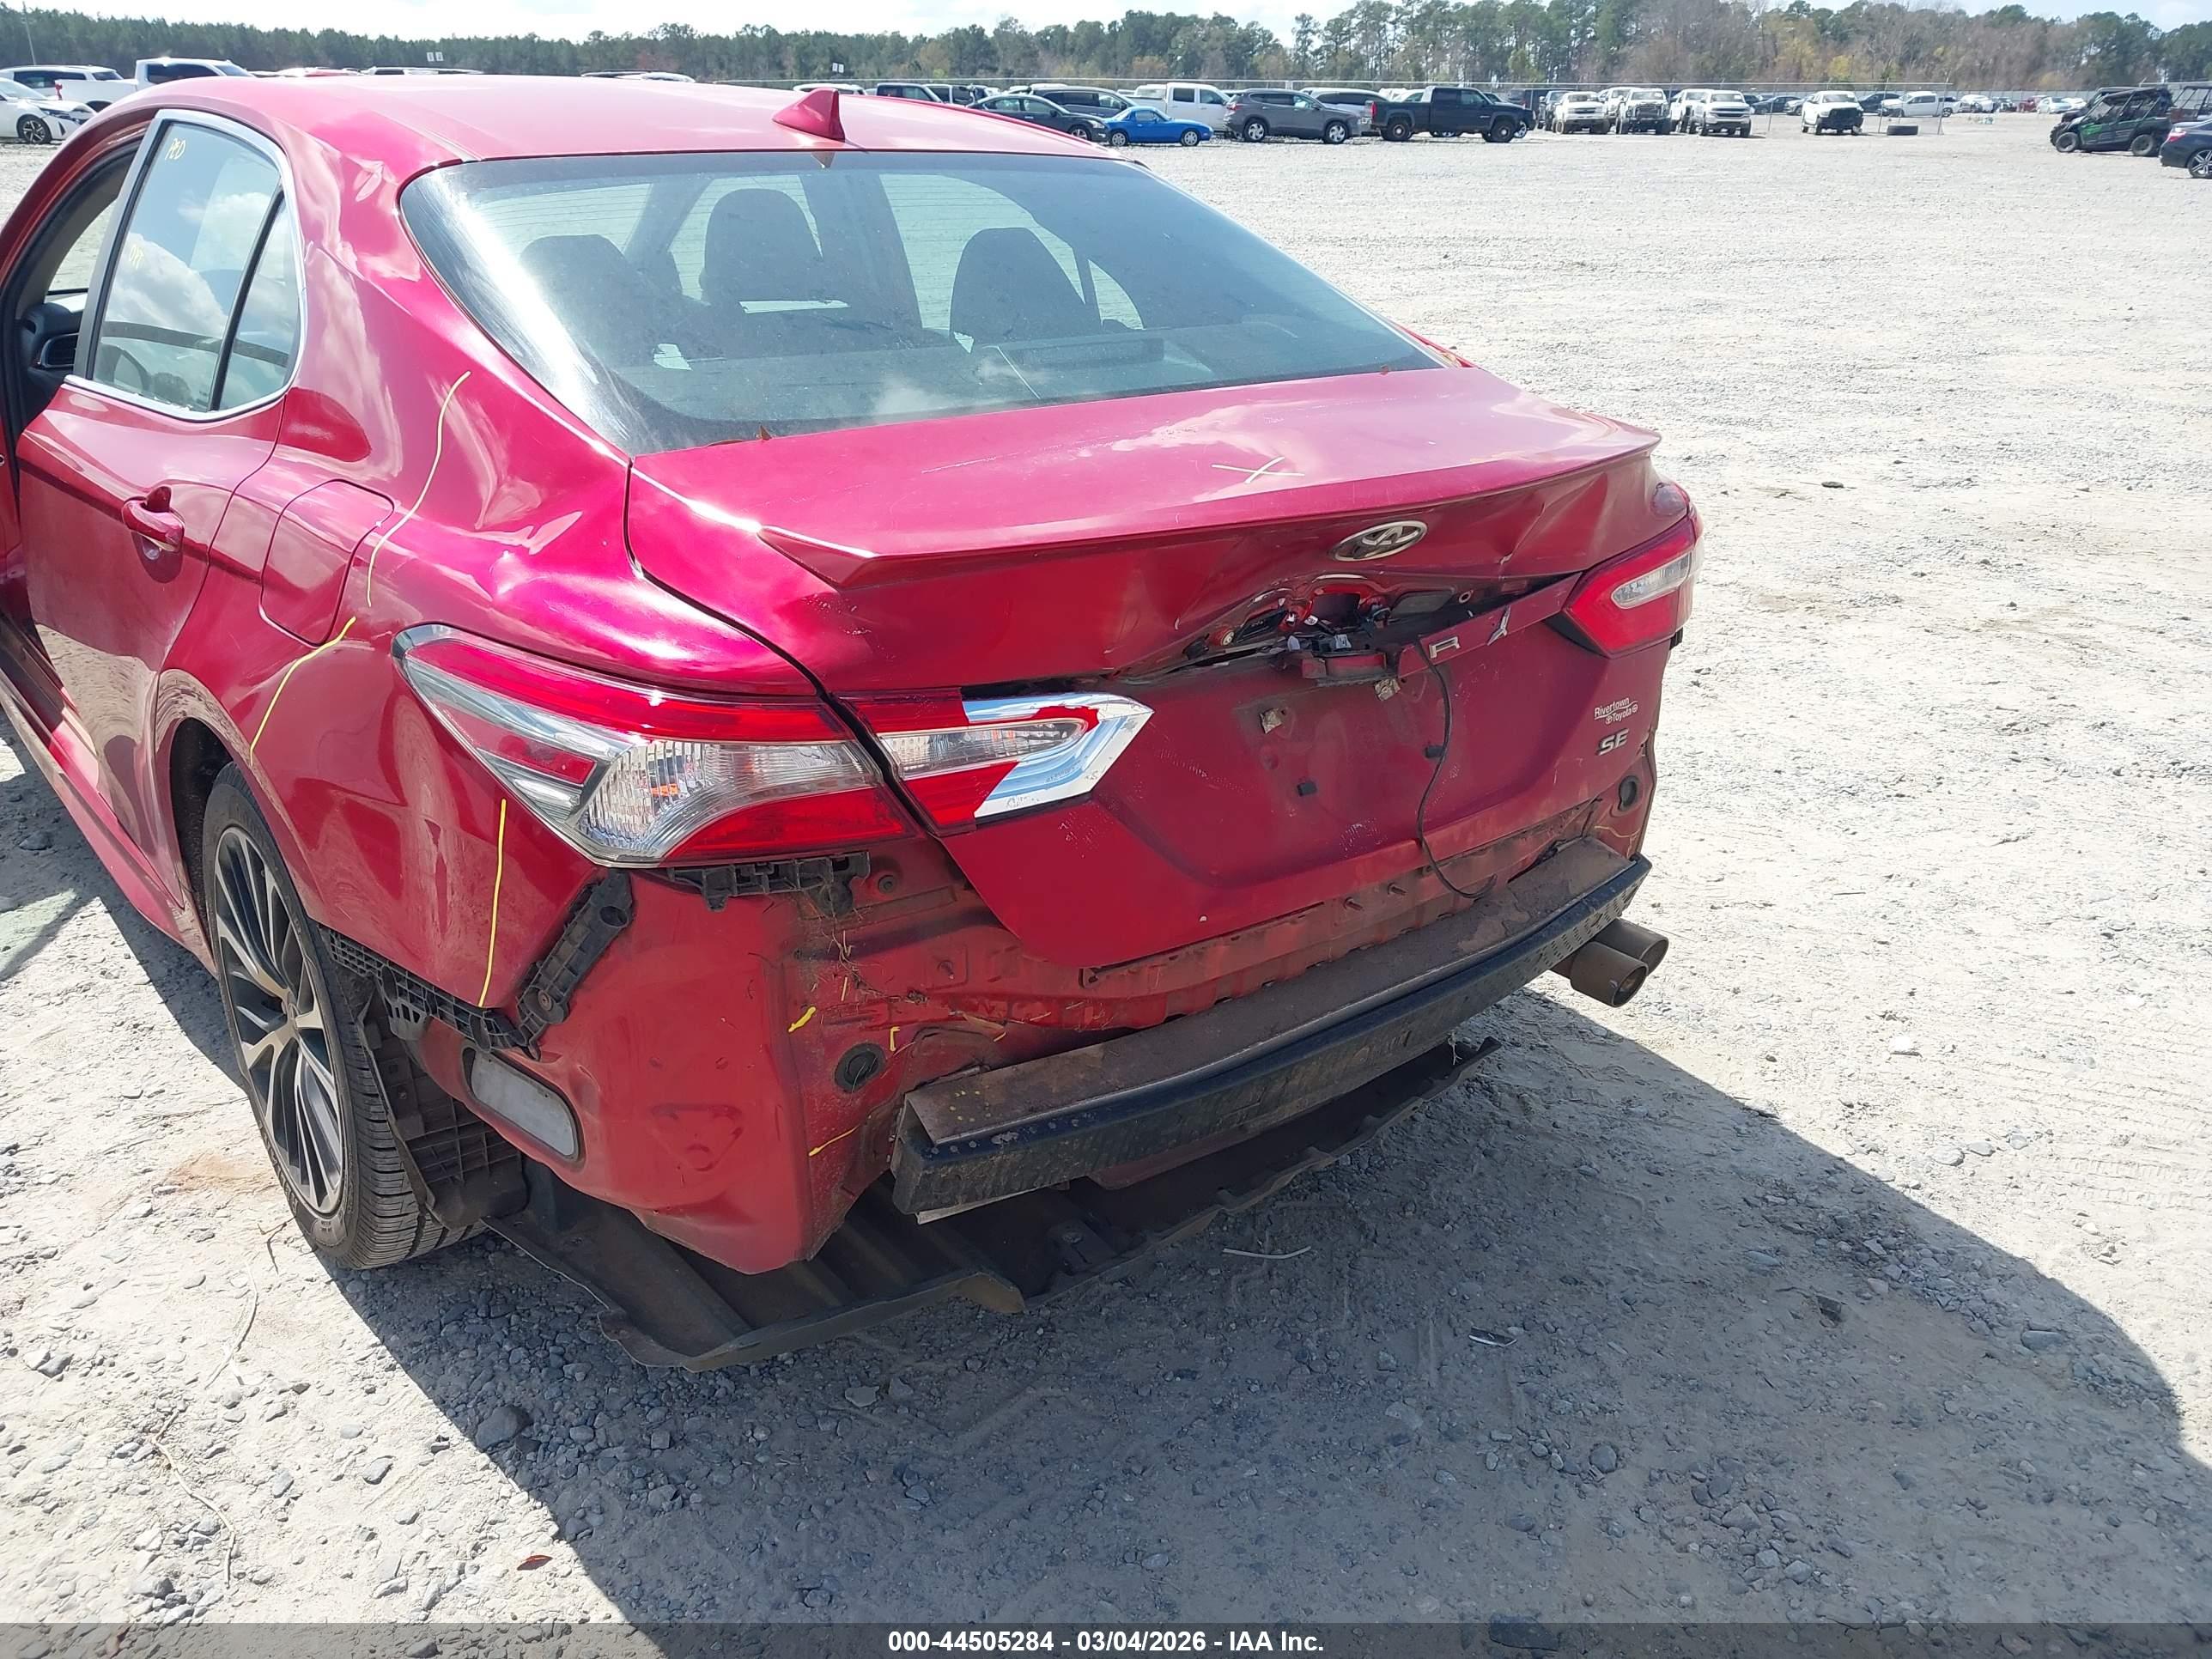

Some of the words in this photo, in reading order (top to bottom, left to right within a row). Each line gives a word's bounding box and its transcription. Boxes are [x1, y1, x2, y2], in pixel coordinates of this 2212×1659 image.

[1595, 697, 1630, 717] Rivertown
[1612, 708, 1632, 722] Toyota
[1597, 728, 1629, 756] SE
